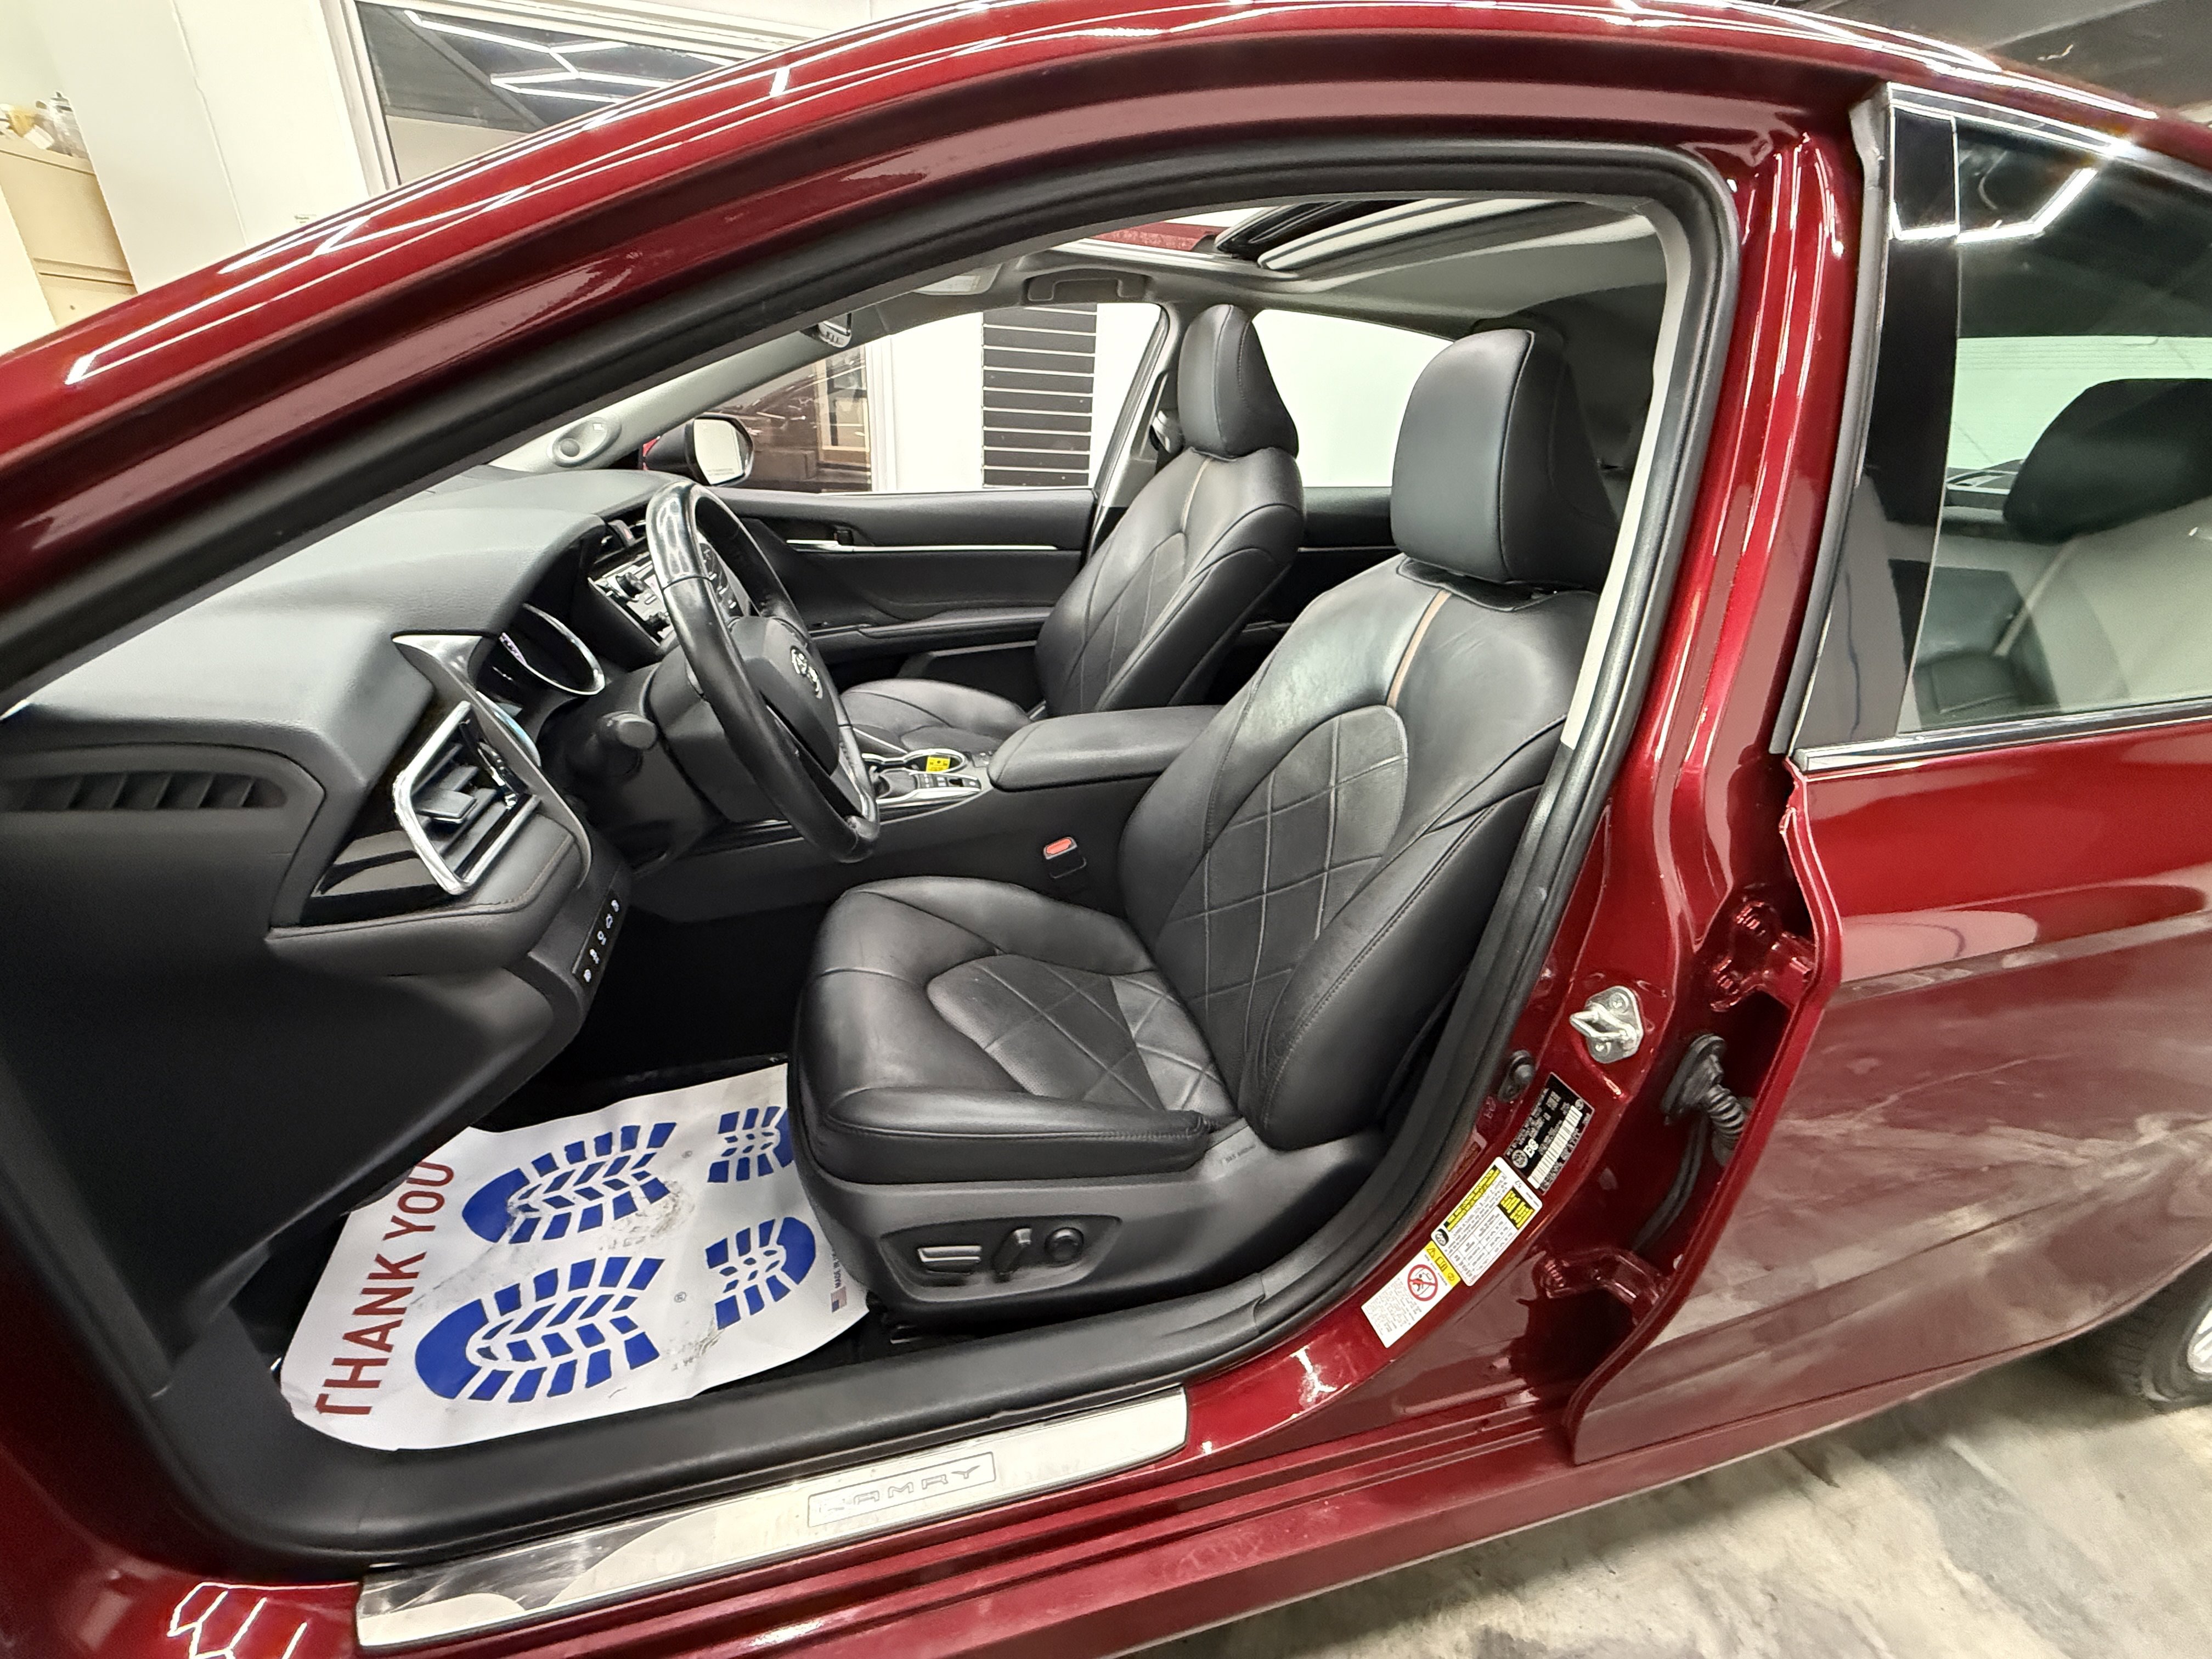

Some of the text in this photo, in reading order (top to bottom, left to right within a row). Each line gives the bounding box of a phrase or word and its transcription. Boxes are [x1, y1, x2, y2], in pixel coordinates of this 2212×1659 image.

[315, 1161, 454, 1415] THANK YOU
[819, 1465, 981, 1513] AMRY
